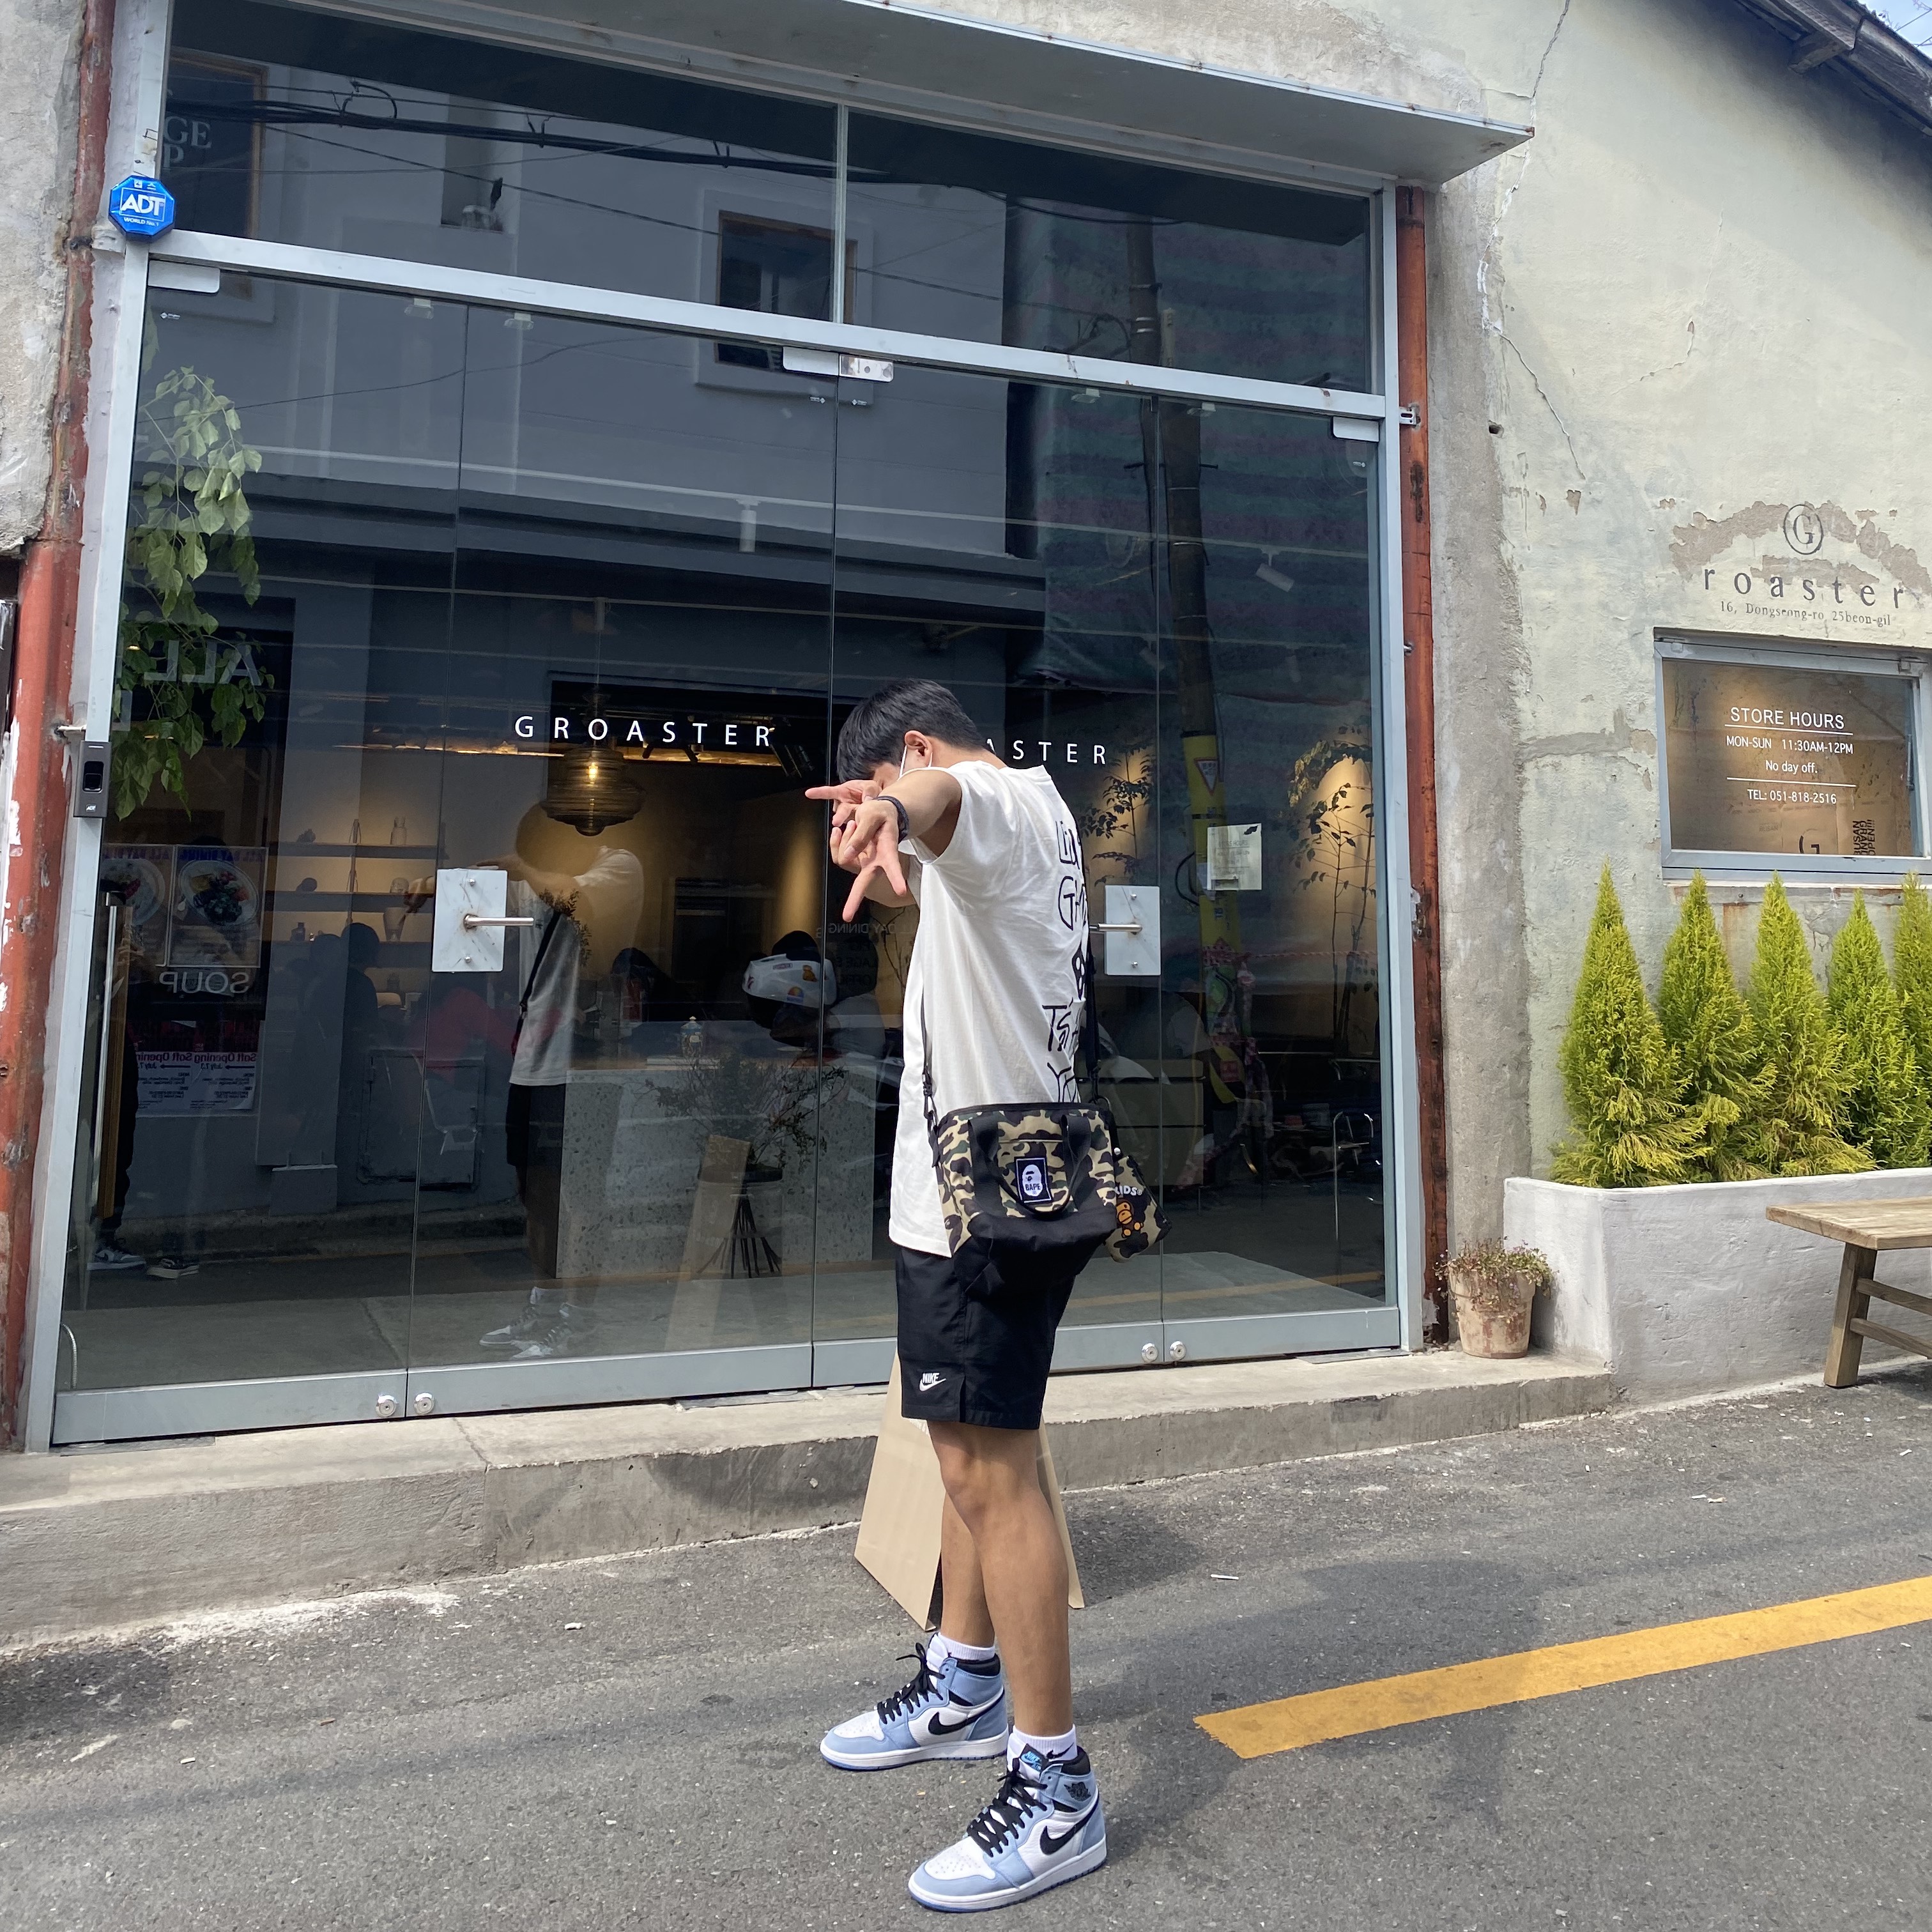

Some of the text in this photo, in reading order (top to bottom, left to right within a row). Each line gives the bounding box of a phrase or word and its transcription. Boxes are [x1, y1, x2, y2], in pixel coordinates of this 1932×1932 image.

[120, 194, 164, 216] ADT
[1704, 569, 1904, 609] roaster
[1832, 610, 1891, 627] 25beon-gil
[1730, 707, 1844, 730] STORE HOURS
[514, 715, 769, 747] GROASTER
[1726, 735, 1853, 755] MON-SUN 11:30AM-12PM
[1765, 760, 1818, 775] No day off.
[1747, 789, 1837, 804] TEL: 051-818-2516
[923, 1372, 940, 1384] NIKE
